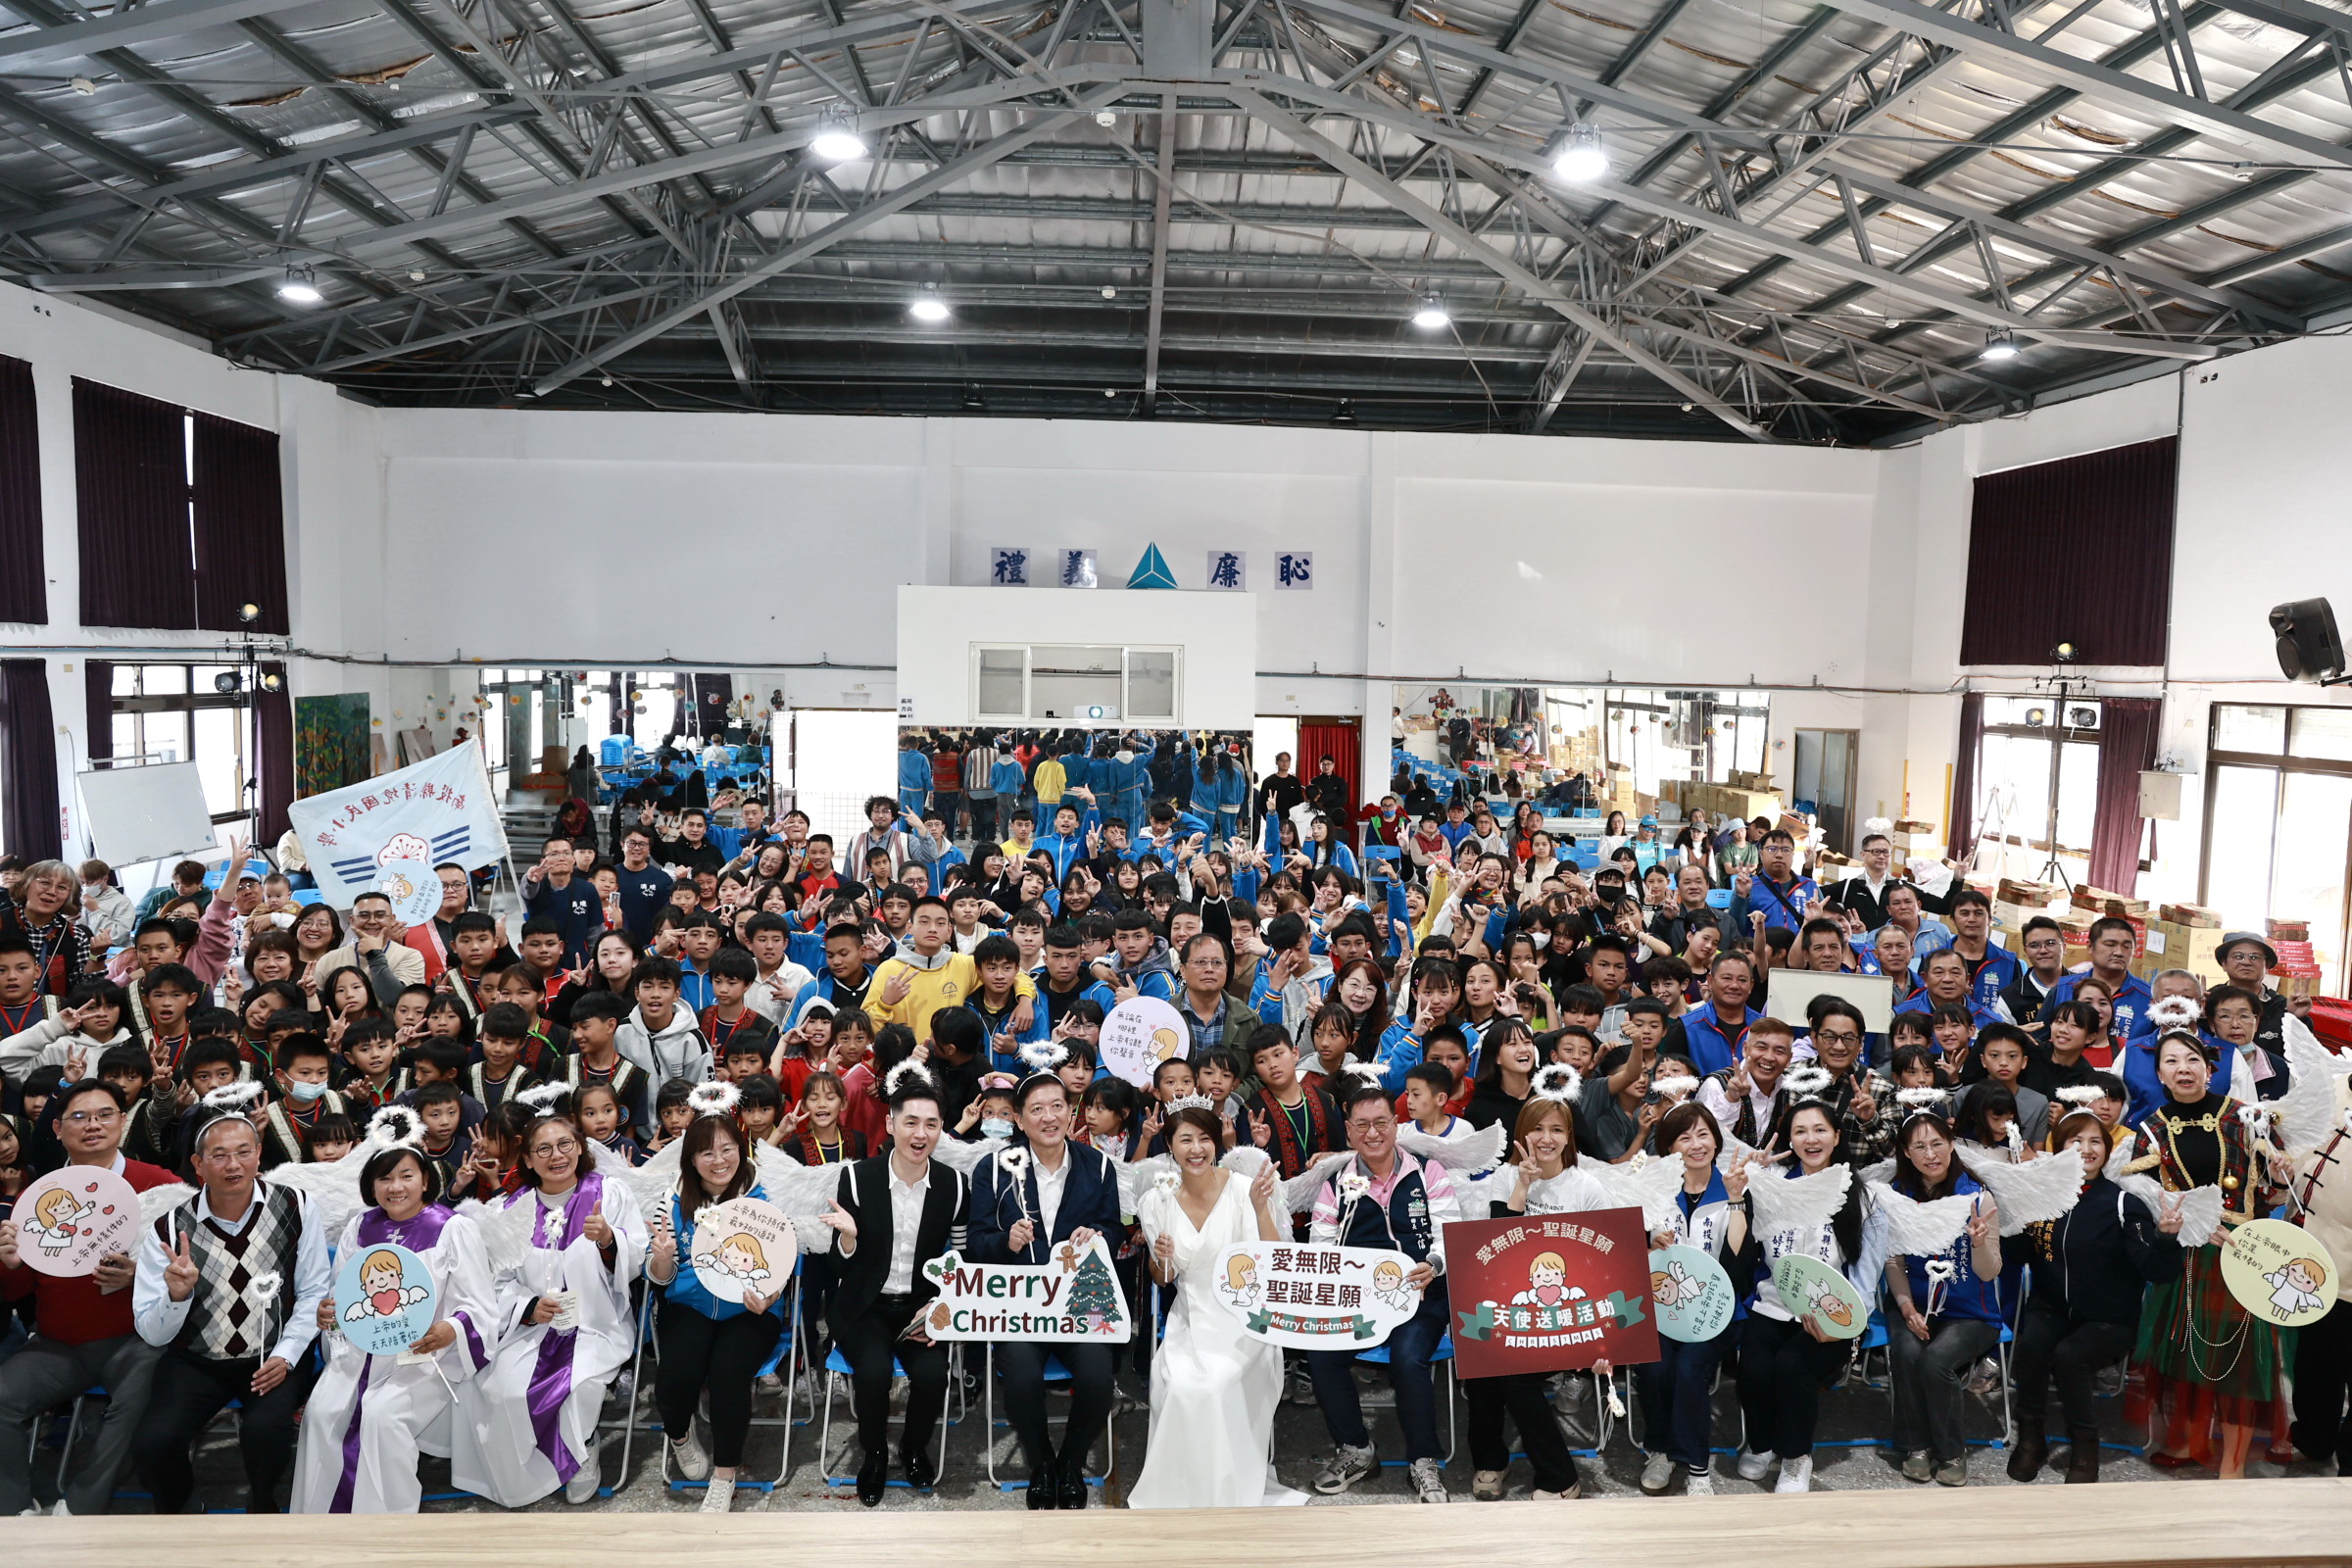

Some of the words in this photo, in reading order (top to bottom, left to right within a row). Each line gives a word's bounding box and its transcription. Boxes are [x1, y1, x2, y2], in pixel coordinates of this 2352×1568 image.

[995, 551, 1026, 584] 禮
[1211, 554, 1243, 588] 廉
[1279, 555, 1310, 586] 恥
[1116, 1011, 1143, 1024] 無論在
[1109, 1047, 1135, 1059] 你聲音
[728, 1215, 777, 1244] 最好的道路
[731, 1203, 787, 1233] 上帝為你預備
[72, 1214, 128, 1267] 上帝無條件的
[1475, 1221, 1615, 1266] 愛無限～聖誕星願
[1702, 1216, 1713, 1253] 南投縣
[2237, 1238, 2258, 1255] 你是
[2243, 1227, 2290, 1257] 在上帝眼中
[1271, 1248, 1365, 1275] 愛無限～
[2232, 1249, 2264, 1271] 最棒的
[956, 1267, 1061, 1306] Merry
[1266, 1280, 1362, 1308] 聖誕星願
[372, 1314, 410, 1334] 上帝的愛
[953, 1308, 1089, 1334] Christmas
[1270, 1314, 1301, 1332] Merry
[1302, 1318, 1354, 1332] Christmas
[1493, 1298, 1616, 1329] 天使送暖活動
[370, 1330, 419, 1350] 天天陪著你
[1506, 1327, 1603, 1347] CHRISTMAS
